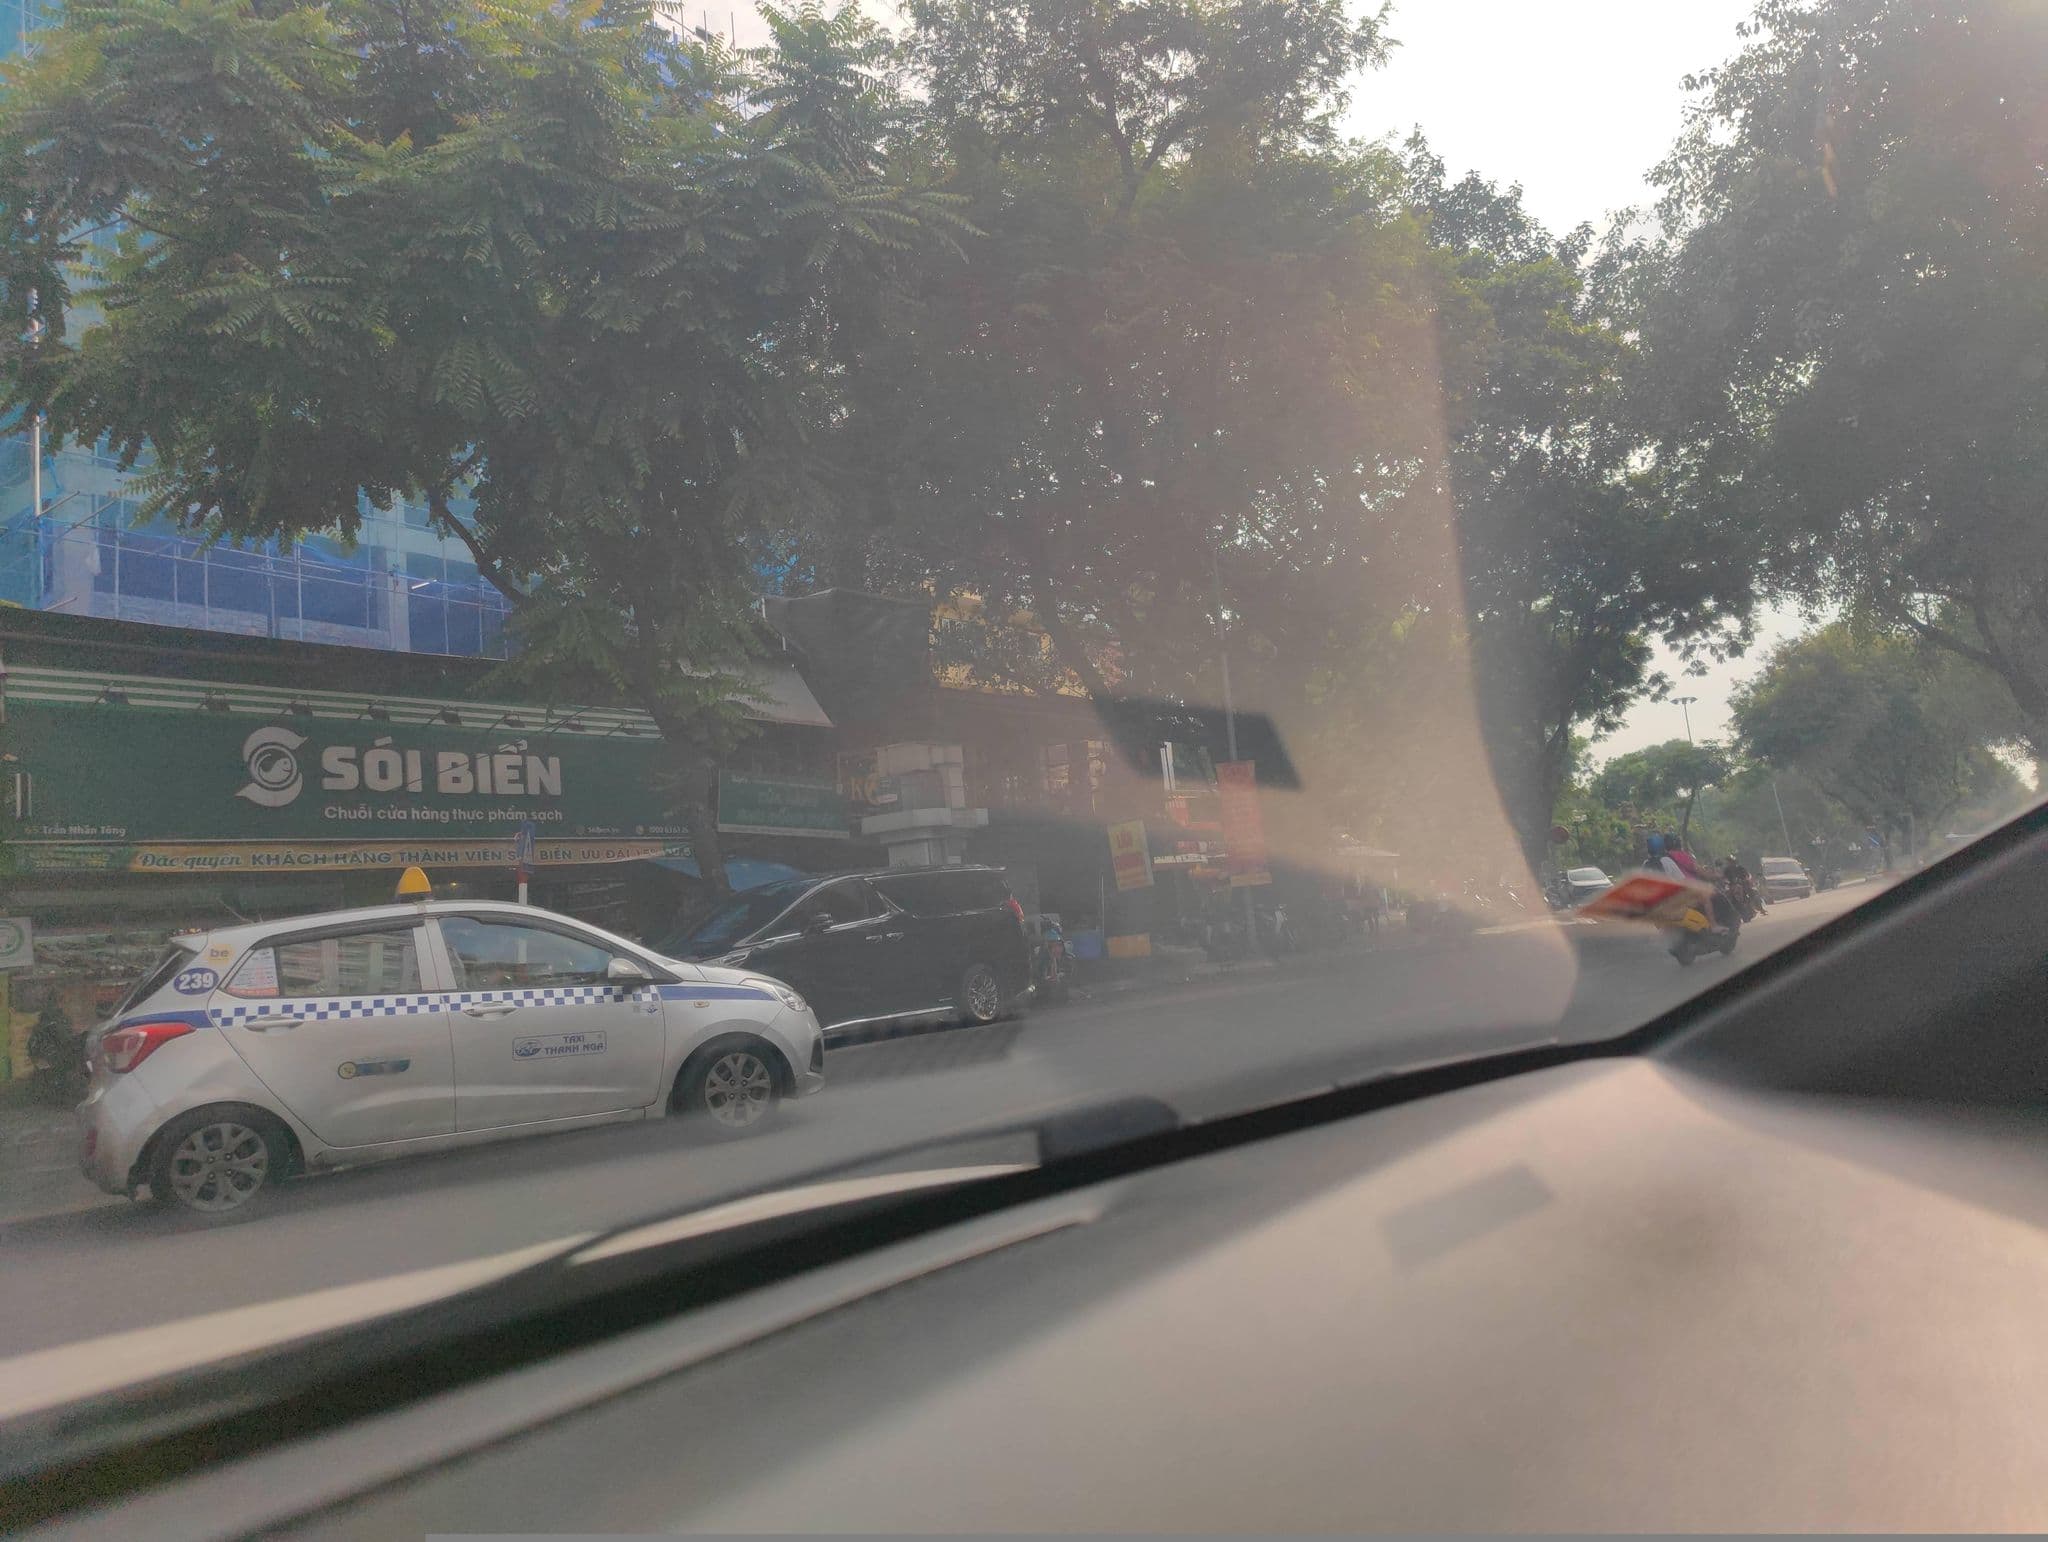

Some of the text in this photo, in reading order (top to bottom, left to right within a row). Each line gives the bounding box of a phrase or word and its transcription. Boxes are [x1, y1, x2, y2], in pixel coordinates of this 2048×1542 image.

[321, 736, 562, 796] SÓI BIỂN
[324, 803, 563, 824] Chuỗi cửa hàng thực phẩm sạch
[251, 850, 327, 866] KHÁCH
[334, 849, 392, 864] HÀNG
[400, 848, 459, 863] THÀNH
[464, 848, 502, 862] VIÊN
[210, 948, 230, 957] be
[178, 972, 215, 991] 239
[563, 1035, 585, 1044] TAXI
